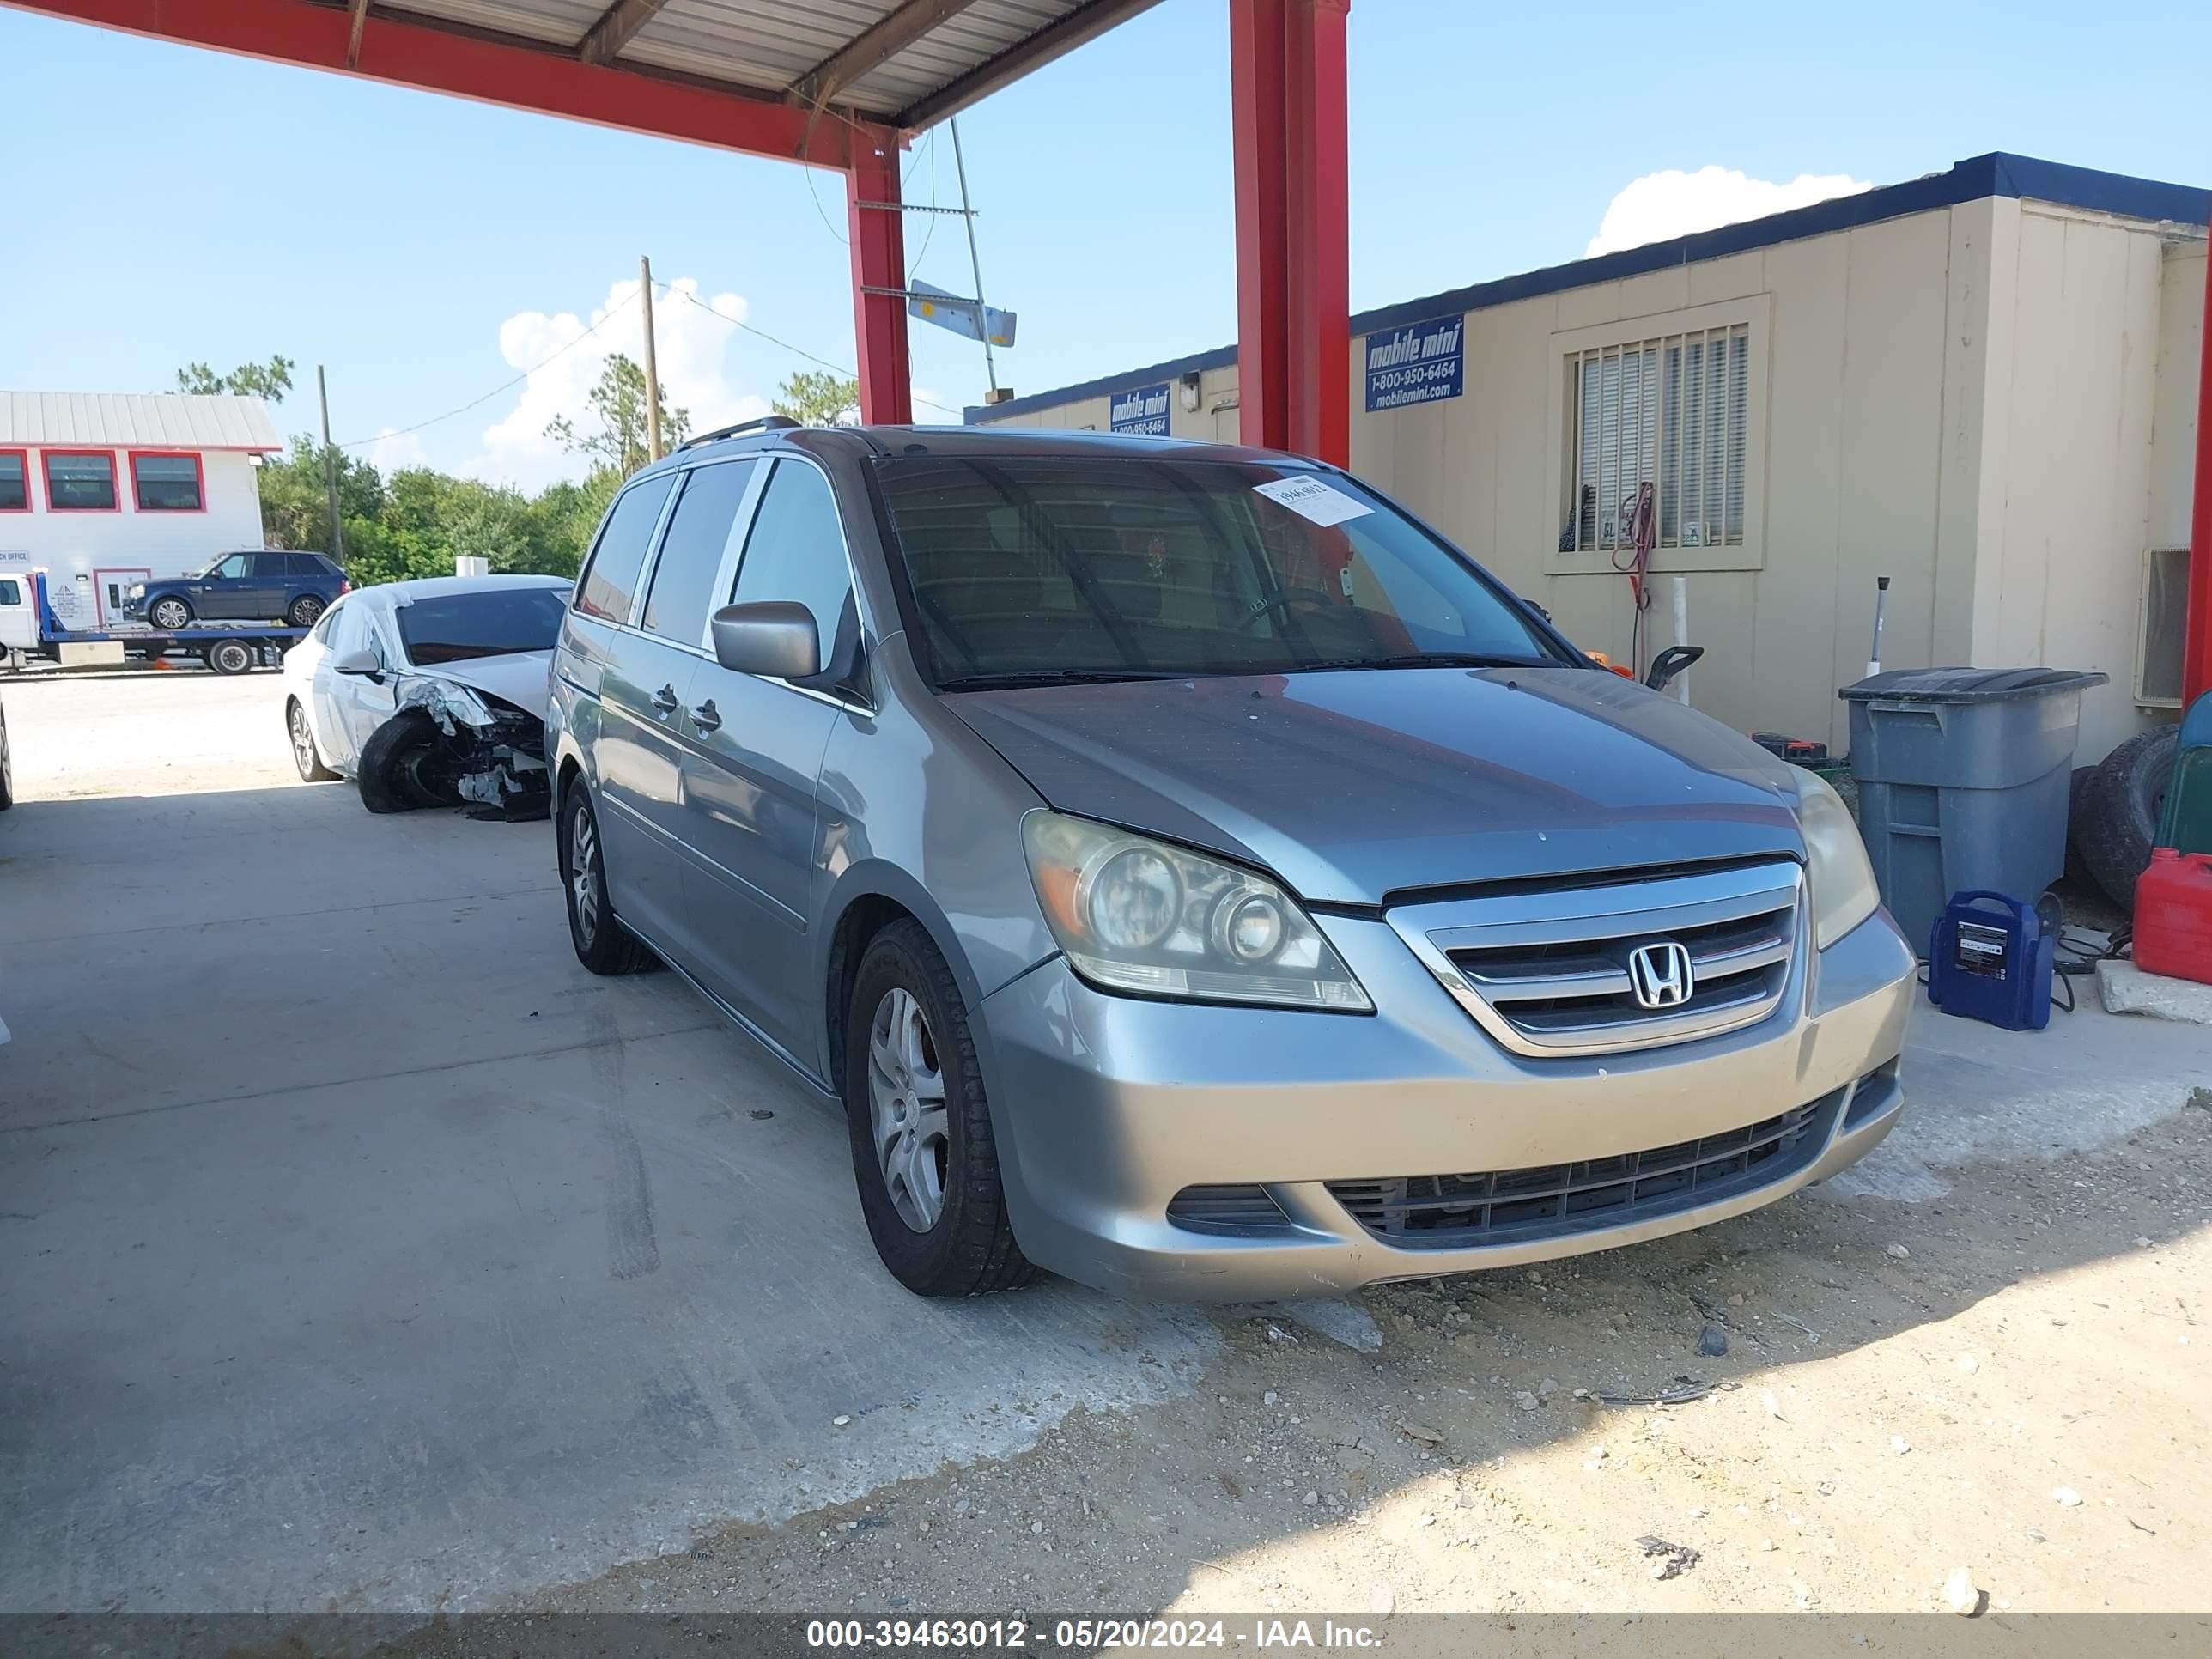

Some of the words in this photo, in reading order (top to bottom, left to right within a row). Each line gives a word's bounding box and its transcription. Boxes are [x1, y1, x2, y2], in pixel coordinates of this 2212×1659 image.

[1369, 328, 1420, 370] mobile
[1421, 322, 1462, 359] mini
[1372, 360, 1455, 392] 1-800-950-6464
[1112, 392, 1145, 422] mobile
[1145, 390, 1169, 416] mini
[1376, 383, 1451, 409] mobilemini.com
[1115, 418, 1166, 435] 00-950-6464
